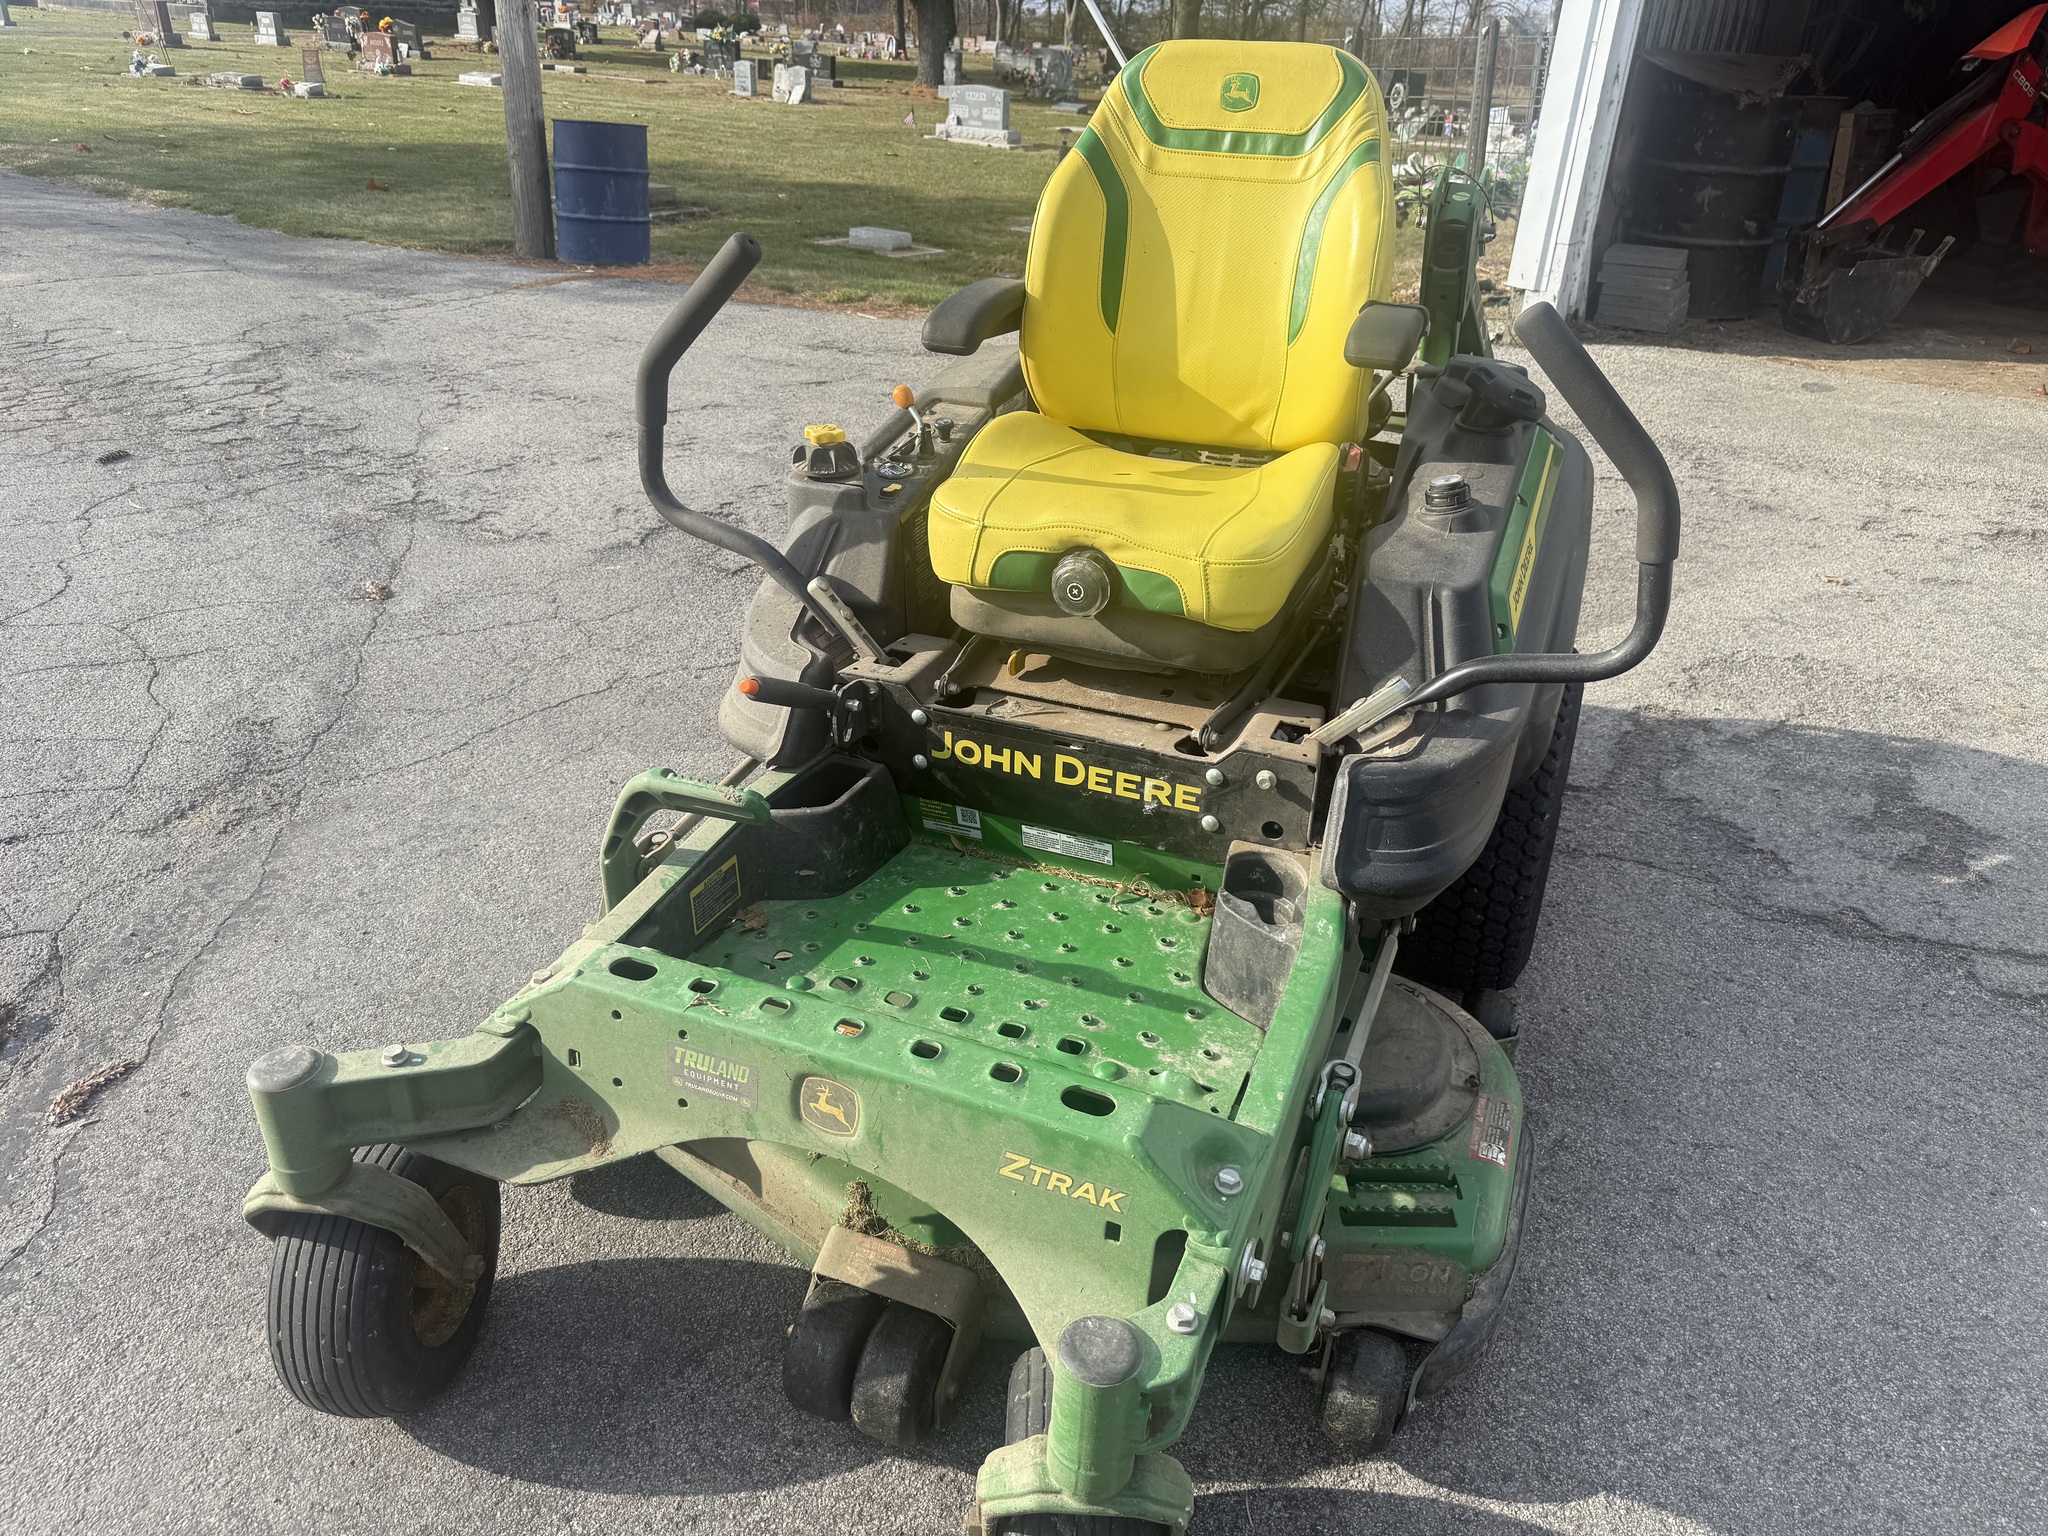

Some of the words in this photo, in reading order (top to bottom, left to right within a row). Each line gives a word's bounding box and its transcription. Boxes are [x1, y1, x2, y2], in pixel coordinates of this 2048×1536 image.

[1513, 573, 1524, 613] JOHN
[1521, 537, 1534, 580] DEERE
[931, 731, 1042, 779] JOHN
[1054, 753, 1202, 813] DEERE
[674, 1046, 750, 1084] TRULAND
[683, 1068, 739, 1091] EQUIPMENT
[998, 1151, 1127, 1213] ZTRAK
